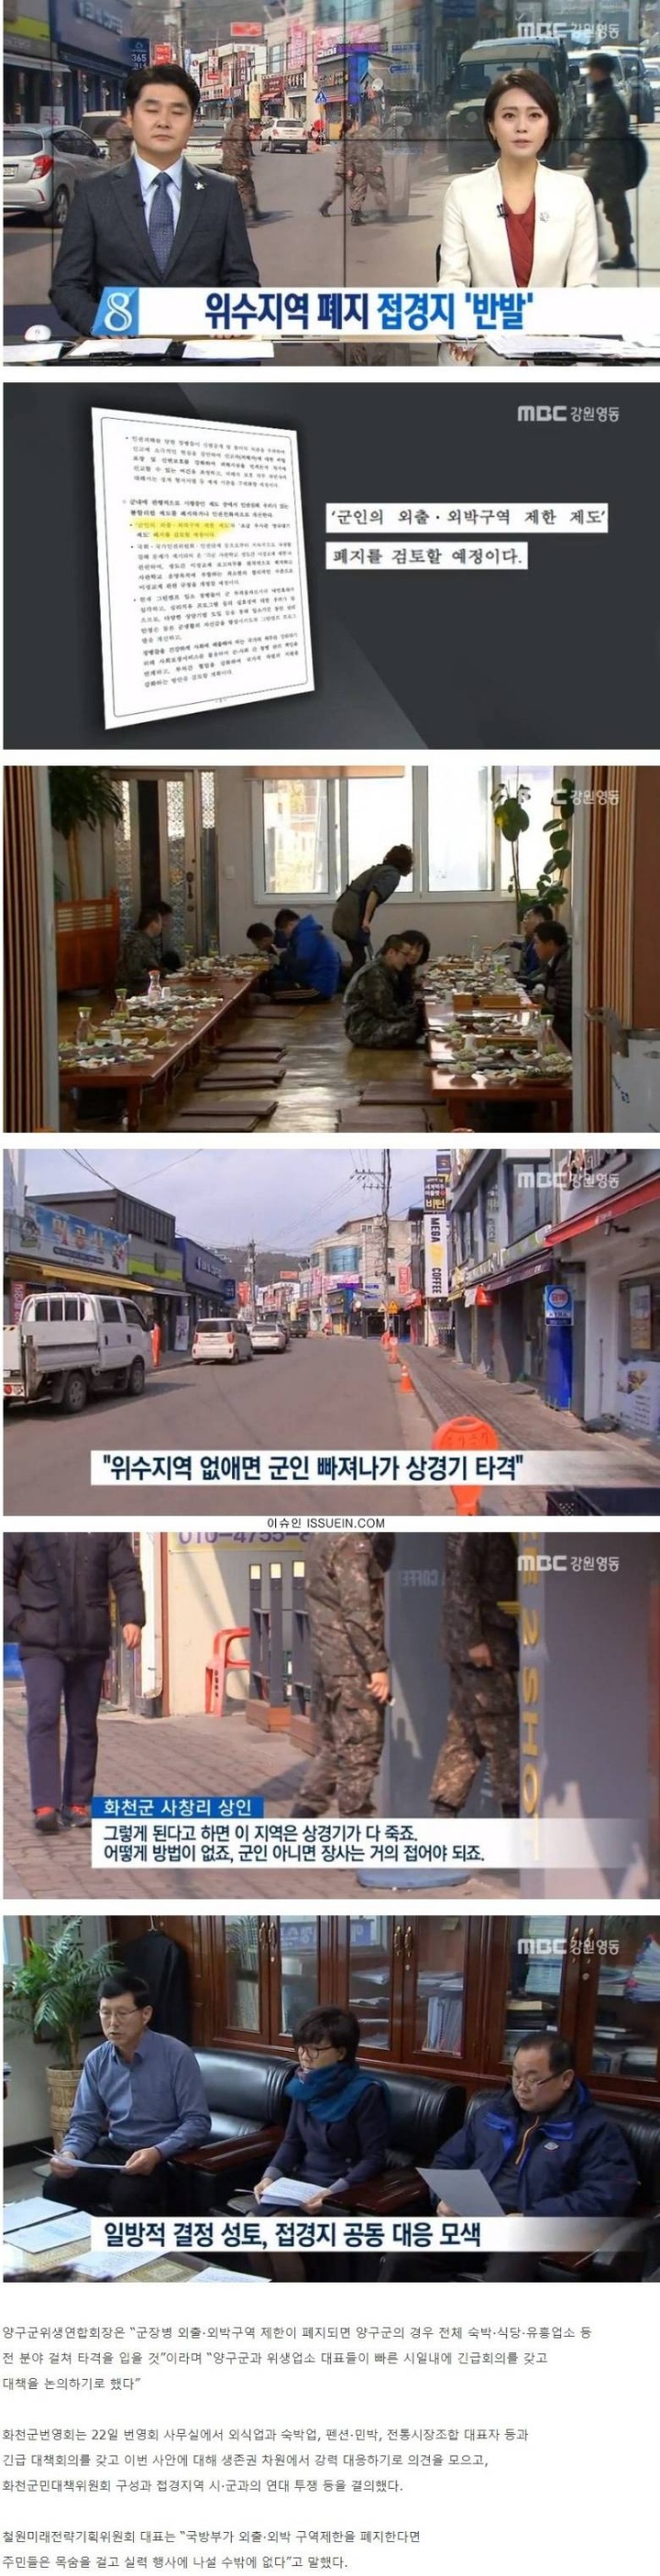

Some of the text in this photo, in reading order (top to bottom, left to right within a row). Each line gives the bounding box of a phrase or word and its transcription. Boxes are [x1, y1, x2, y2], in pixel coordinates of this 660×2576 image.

[131, 53, 147, 62] 365
[431, 1217, 441, 1243] MEGA
[432, 1268, 442, 1294] COFFEE
